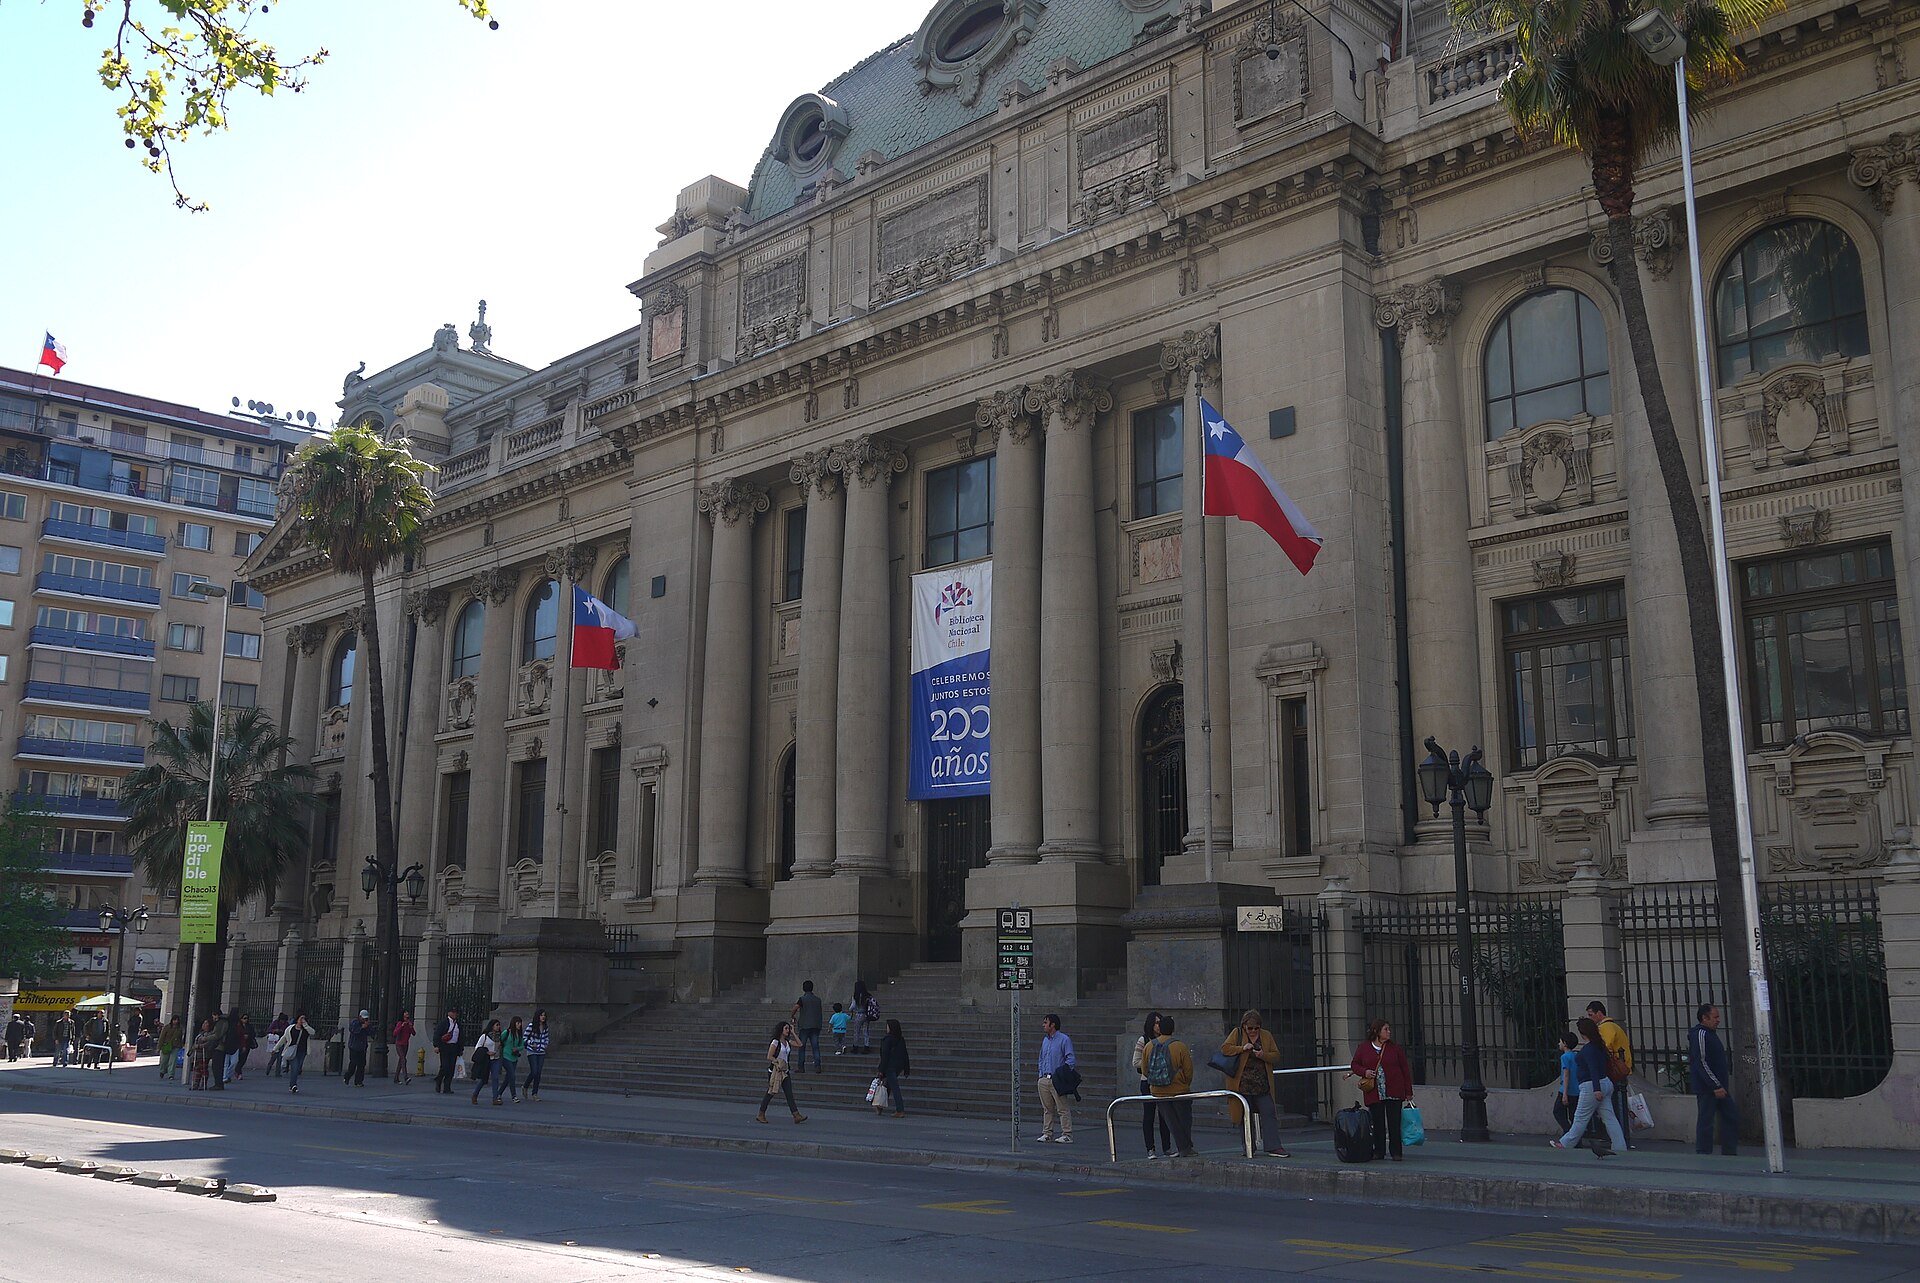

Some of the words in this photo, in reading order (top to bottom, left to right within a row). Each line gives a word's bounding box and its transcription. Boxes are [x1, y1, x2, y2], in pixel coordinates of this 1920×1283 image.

[947, 638, 965, 648] Chile
[931, 671, 991, 686] CELEBREMOS
[930, 689, 960, 703] JUNTOS
[962, 686, 991, 697] ESTOS
[931, 745, 989, 778] años
[189, 830, 207, 843] im
[188, 843, 212, 855] per
[186, 853, 202, 866] di
[185, 866, 207, 879] ble
[1020, 917, 1026, 926] 3
